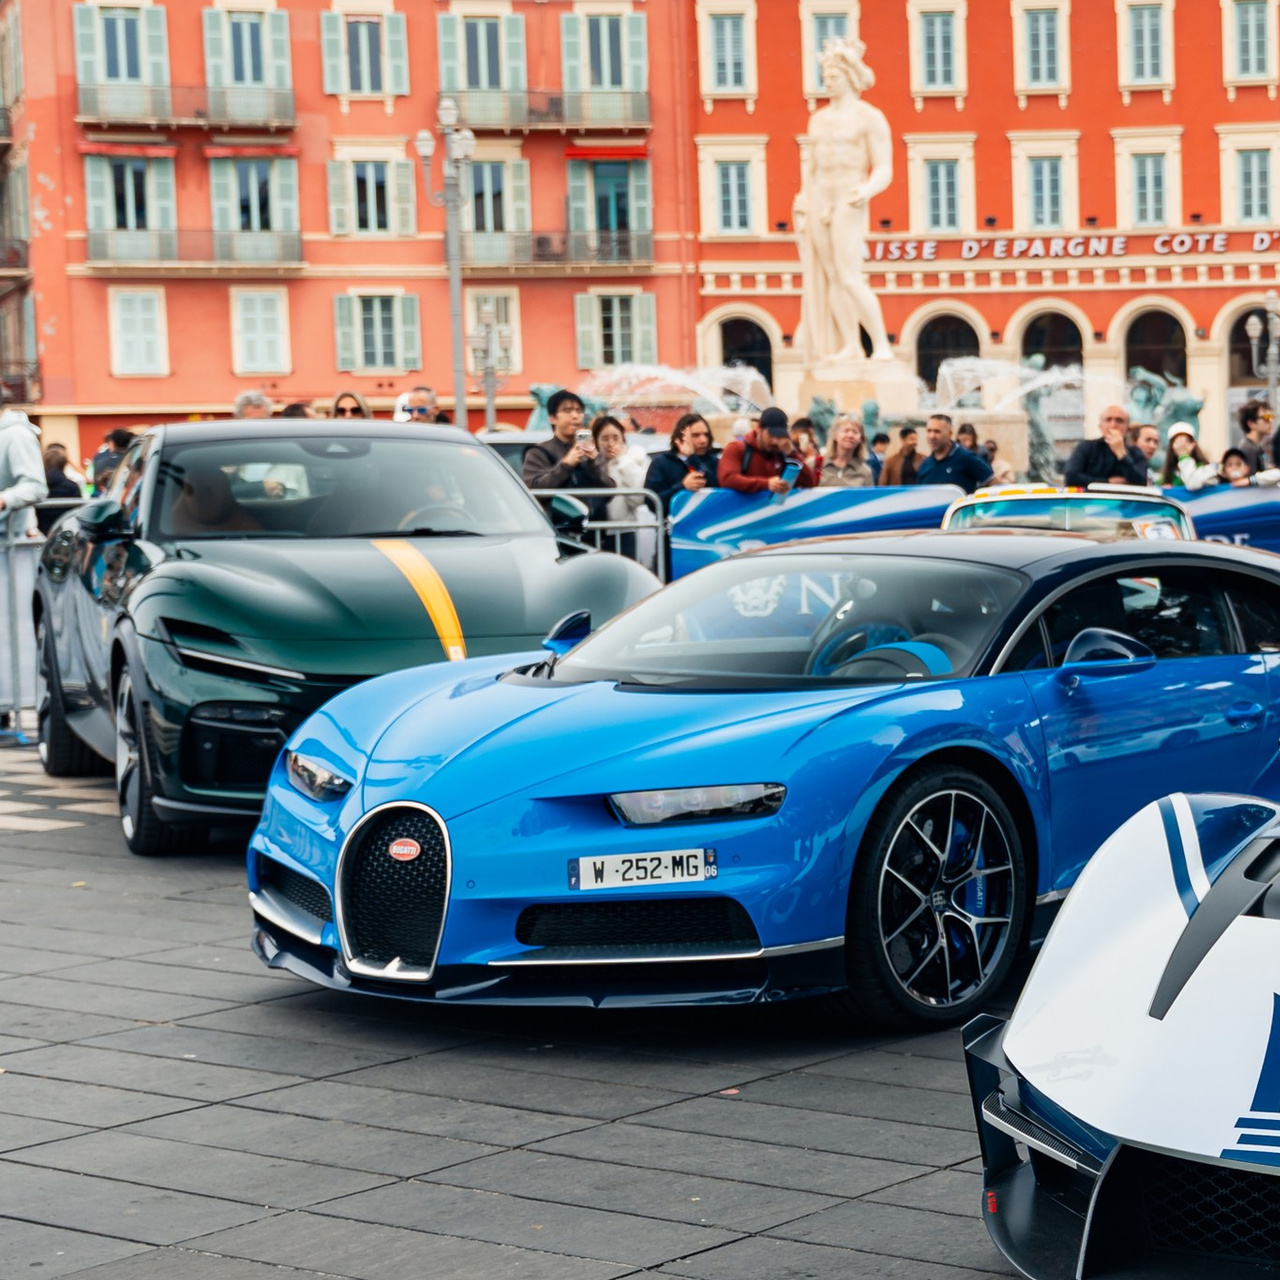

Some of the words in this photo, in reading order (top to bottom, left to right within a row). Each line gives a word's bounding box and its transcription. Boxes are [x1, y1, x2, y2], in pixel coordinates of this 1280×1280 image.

[862, 240, 938, 261] AISSE
[960, 236, 1128, 261] D'EPARGNE
[1153, 233, 1229, 254] COTE
[705, 865, 718, 876] 06
[571, 877, 577, 885] F
